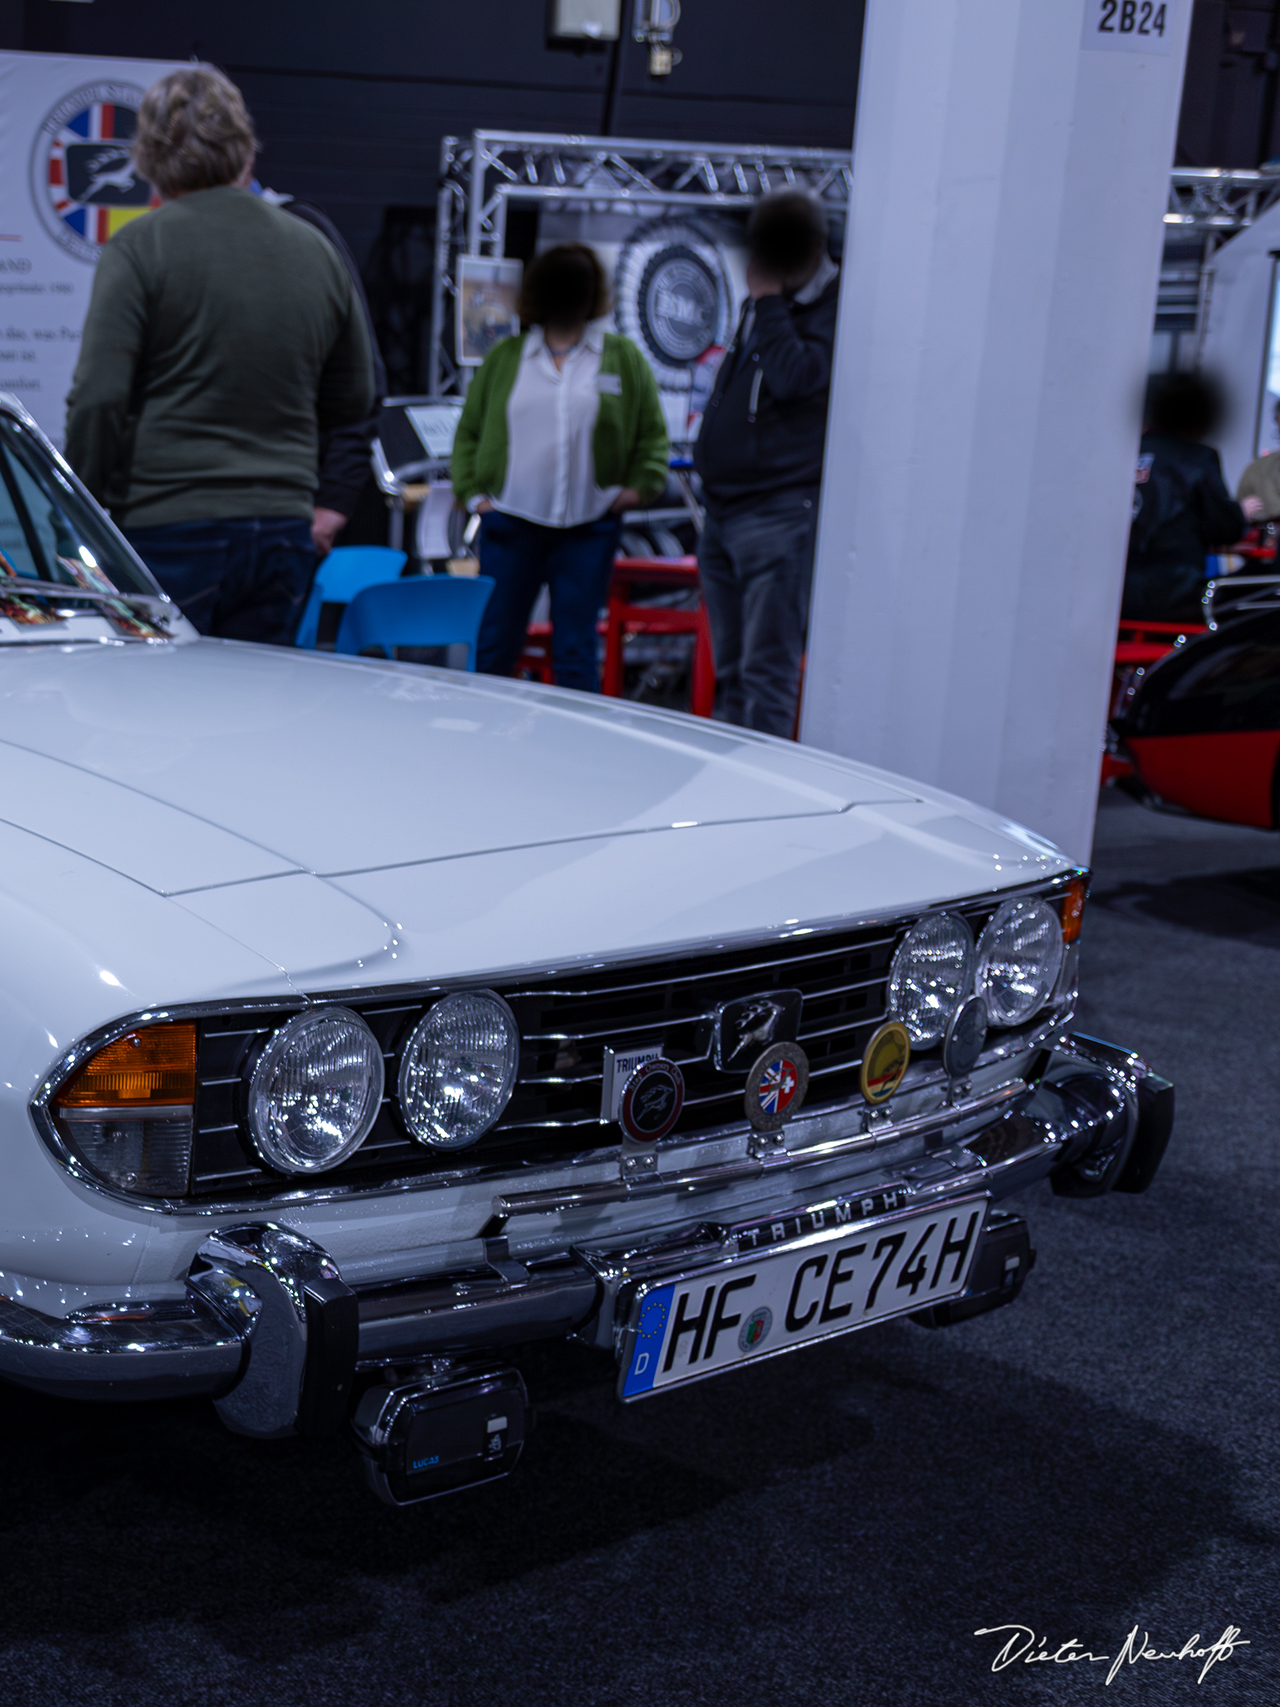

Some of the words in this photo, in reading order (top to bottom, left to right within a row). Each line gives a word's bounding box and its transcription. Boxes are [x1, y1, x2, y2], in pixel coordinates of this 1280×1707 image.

[1098, 0, 1167, 37] 2B24
[746, 1192, 899, 1246] TRIUMPH
[663, 1274, 756, 1373] HF
[634, 1352, 649, 1376] D
